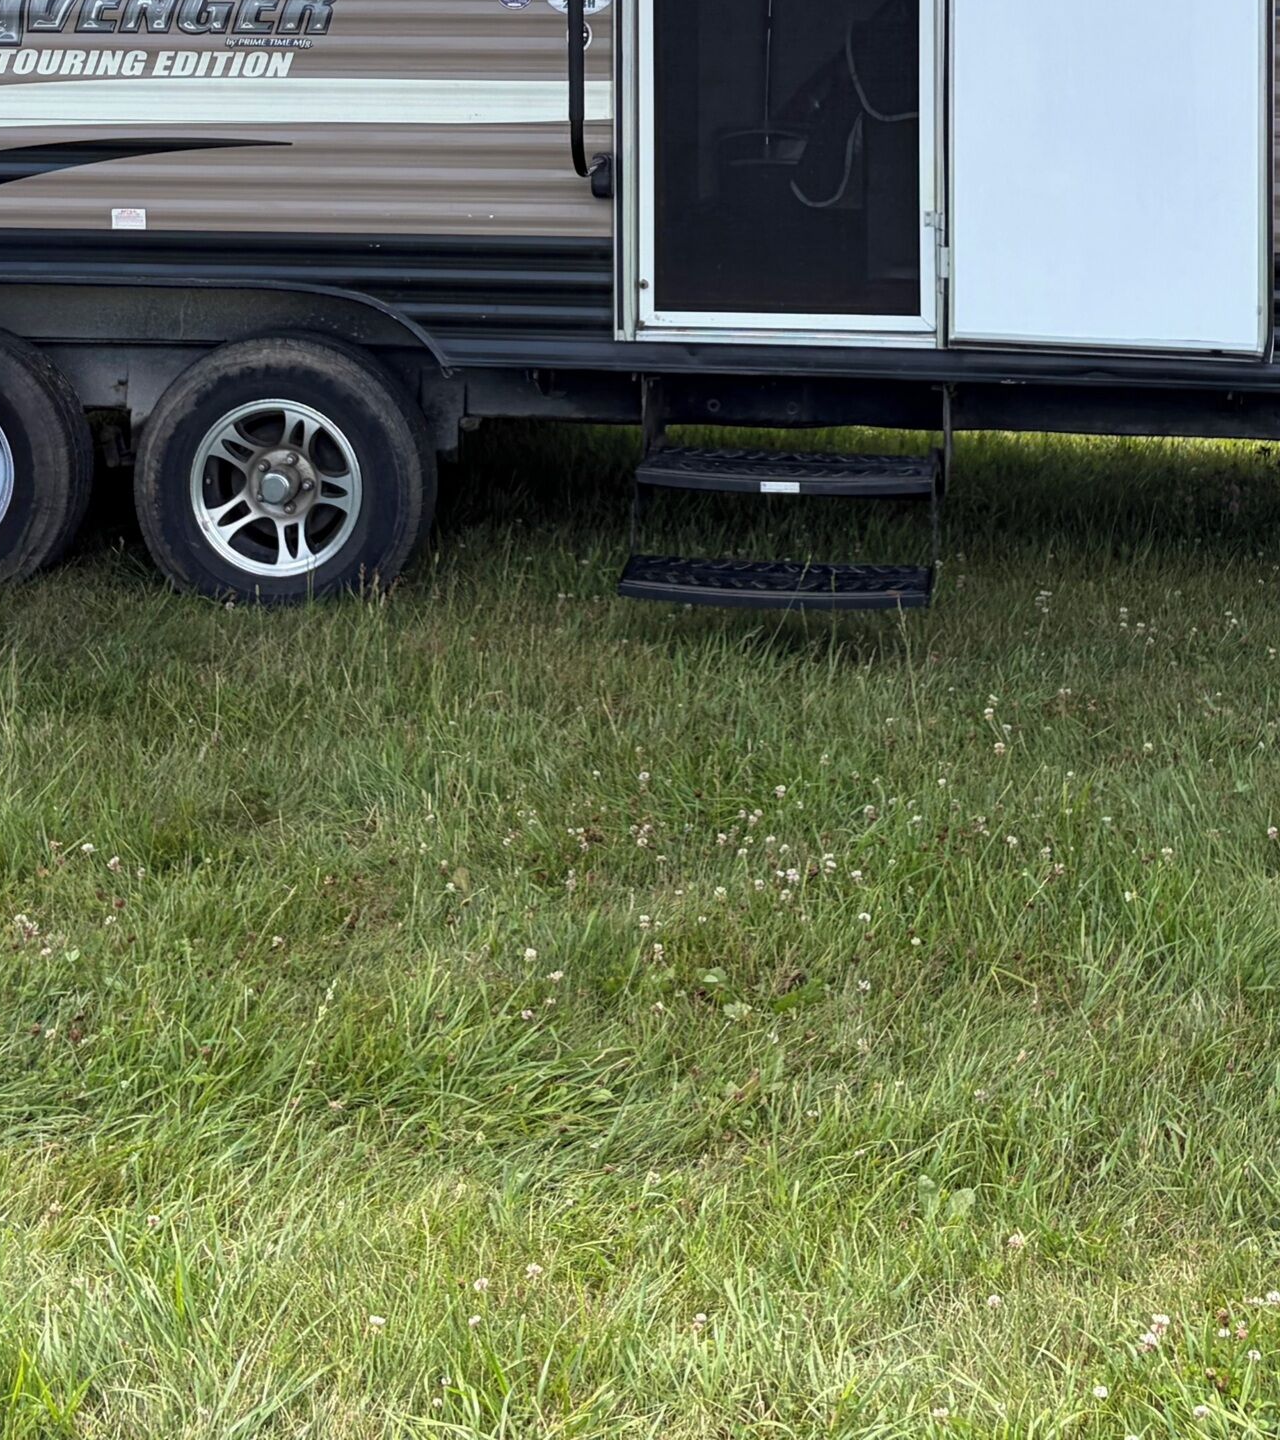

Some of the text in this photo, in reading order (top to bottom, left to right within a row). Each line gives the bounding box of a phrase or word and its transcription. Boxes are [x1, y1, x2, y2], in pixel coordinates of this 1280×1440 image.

[225, 37, 314, 49] by PRIME TIME Mfg.
[152, 50, 295, 79] EDITION
